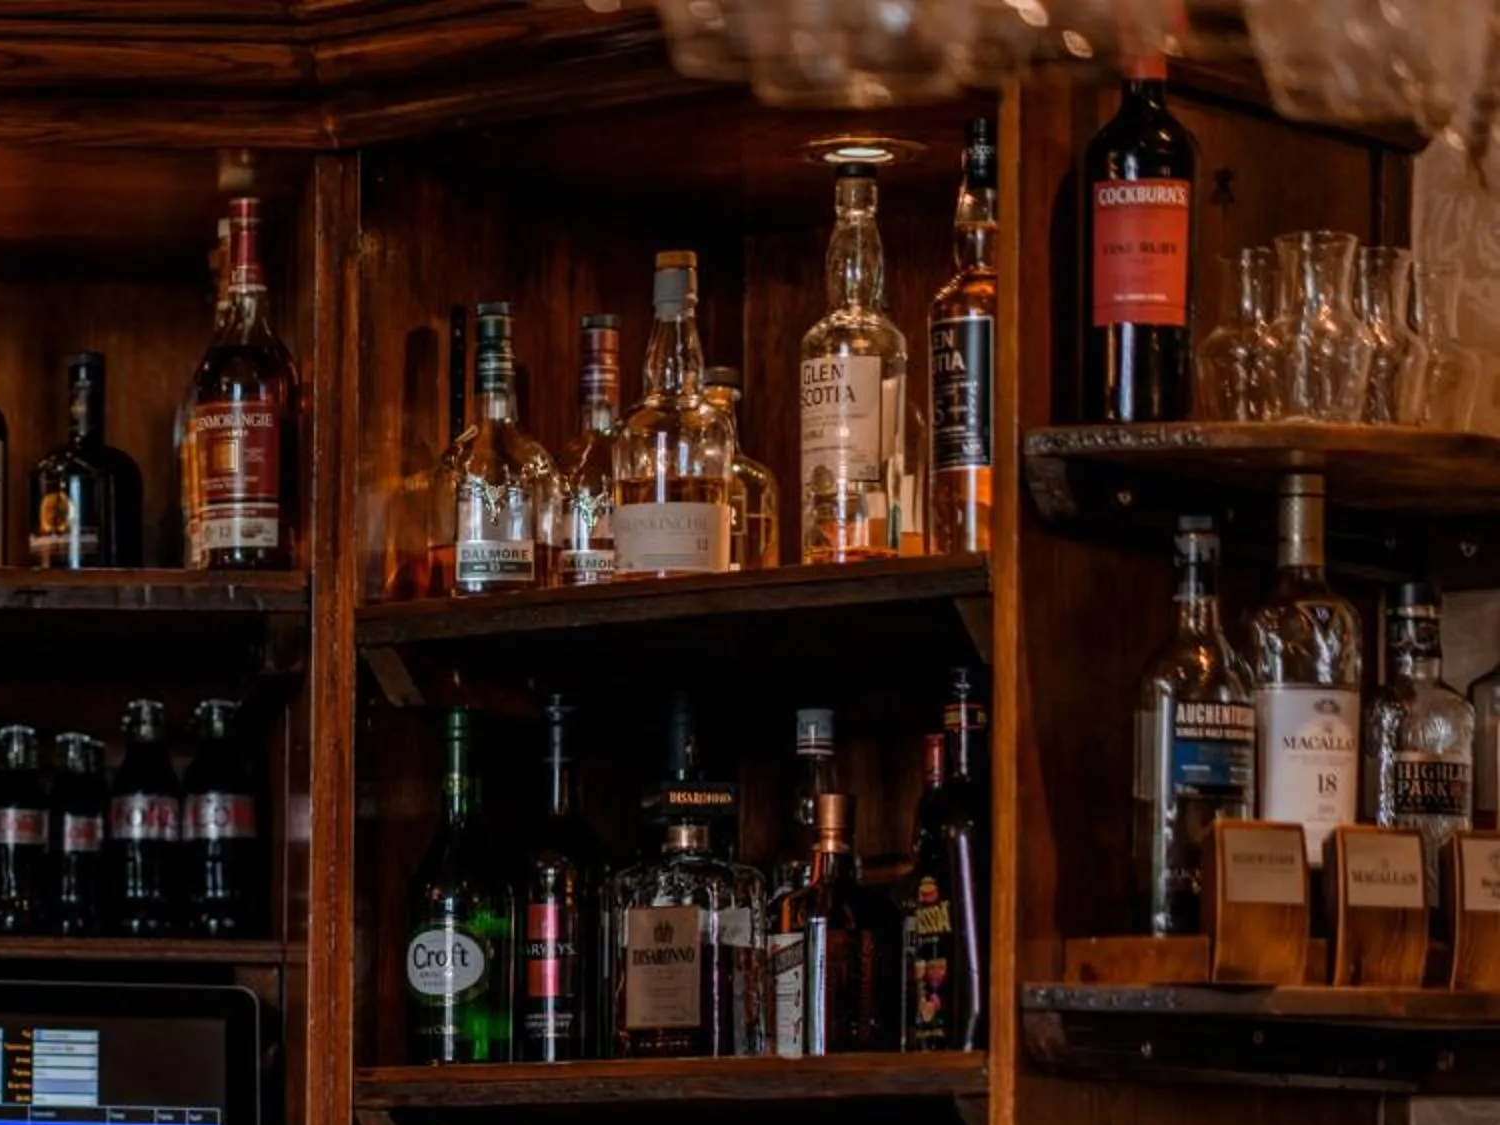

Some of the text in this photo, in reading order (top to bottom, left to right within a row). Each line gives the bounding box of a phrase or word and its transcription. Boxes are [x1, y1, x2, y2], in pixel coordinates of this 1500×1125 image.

[804, 364, 844, 386] GLEN
[461, 548, 529, 561] DALMORE
[1318, 773, 1337, 794] 18
[1397, 780, 1448, 797] PARK
[413, 941, 469, 969] Croft
[632, 946, 696, 966] DISARONNO
